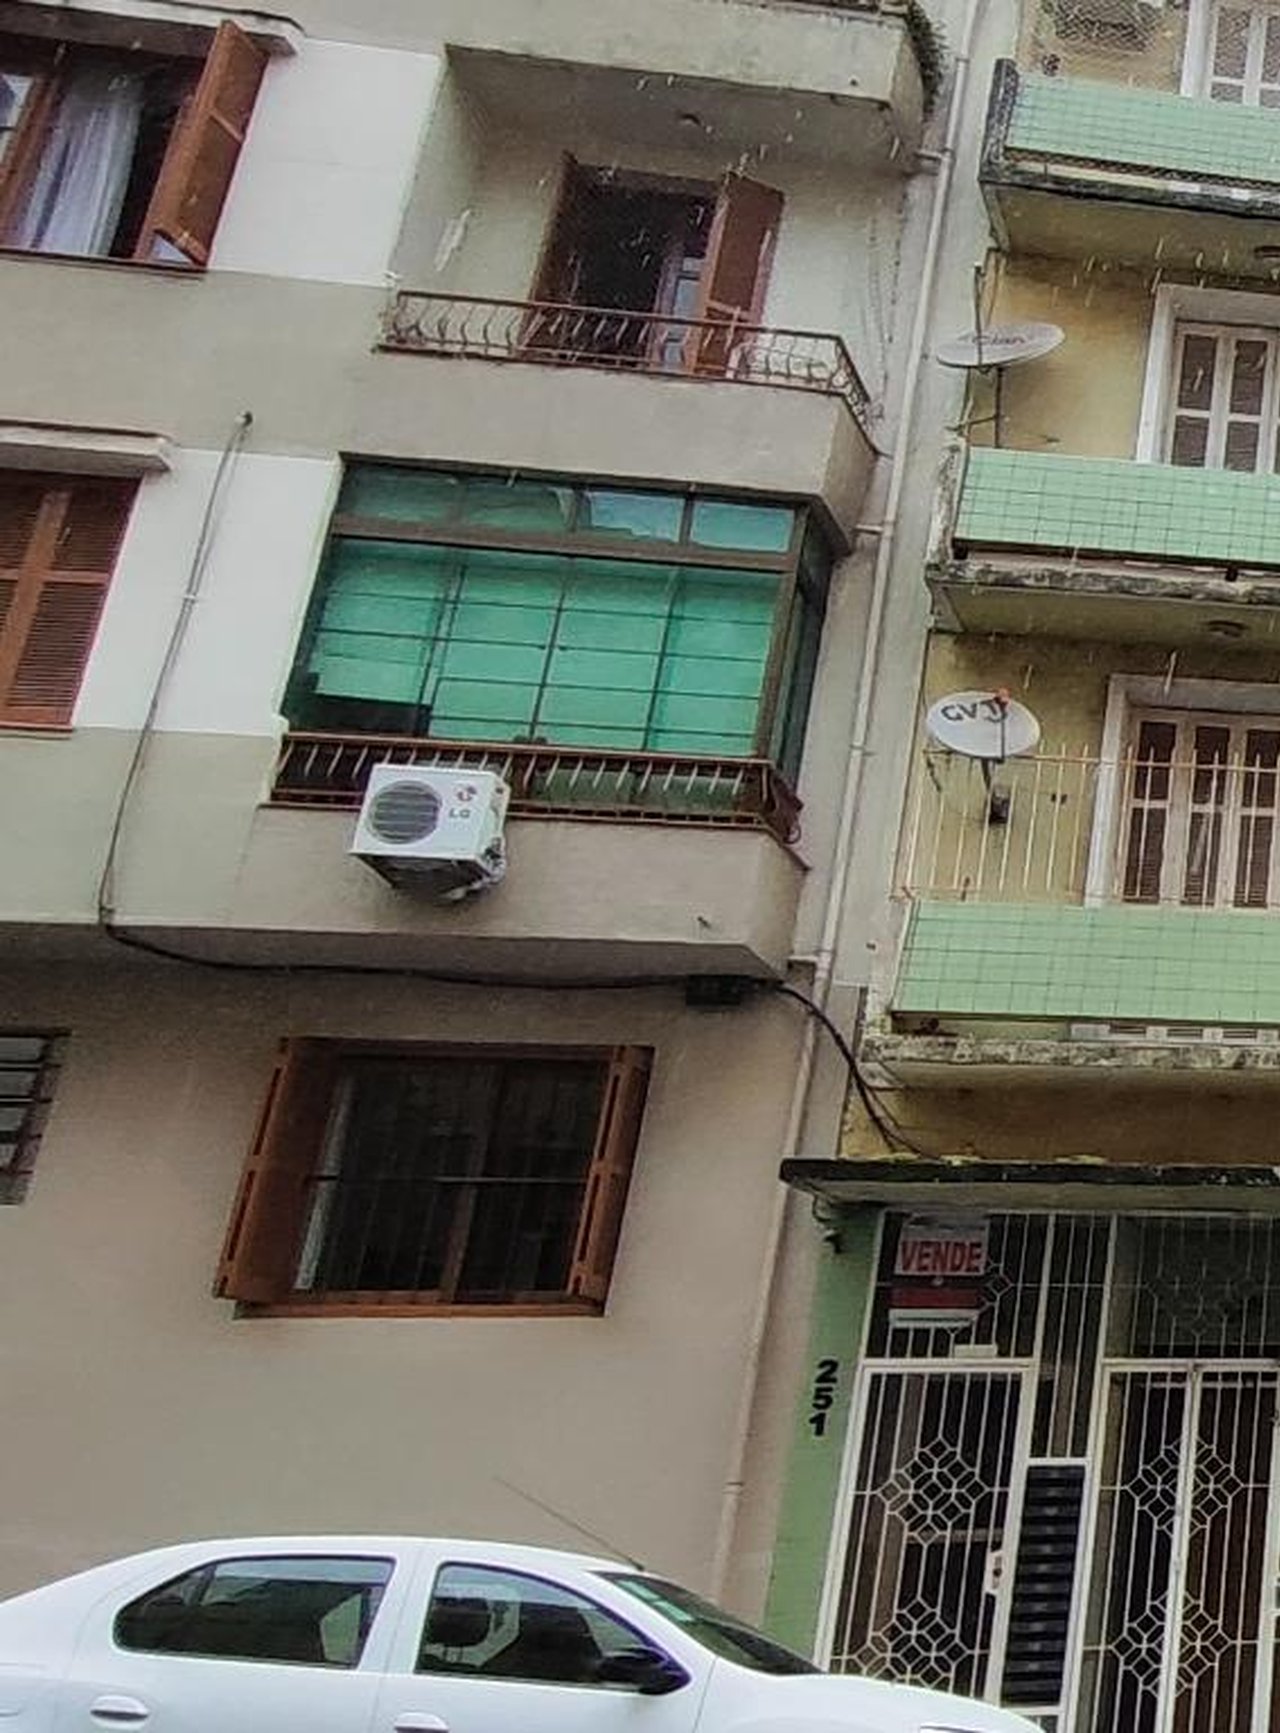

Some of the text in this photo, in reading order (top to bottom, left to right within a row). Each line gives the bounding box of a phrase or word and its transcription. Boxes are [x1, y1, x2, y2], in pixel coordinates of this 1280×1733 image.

[449, 807, 471, 819] LG
[901, 1240, 983, 1273] VENDE
[809, 1359, 839, 1437] 251
